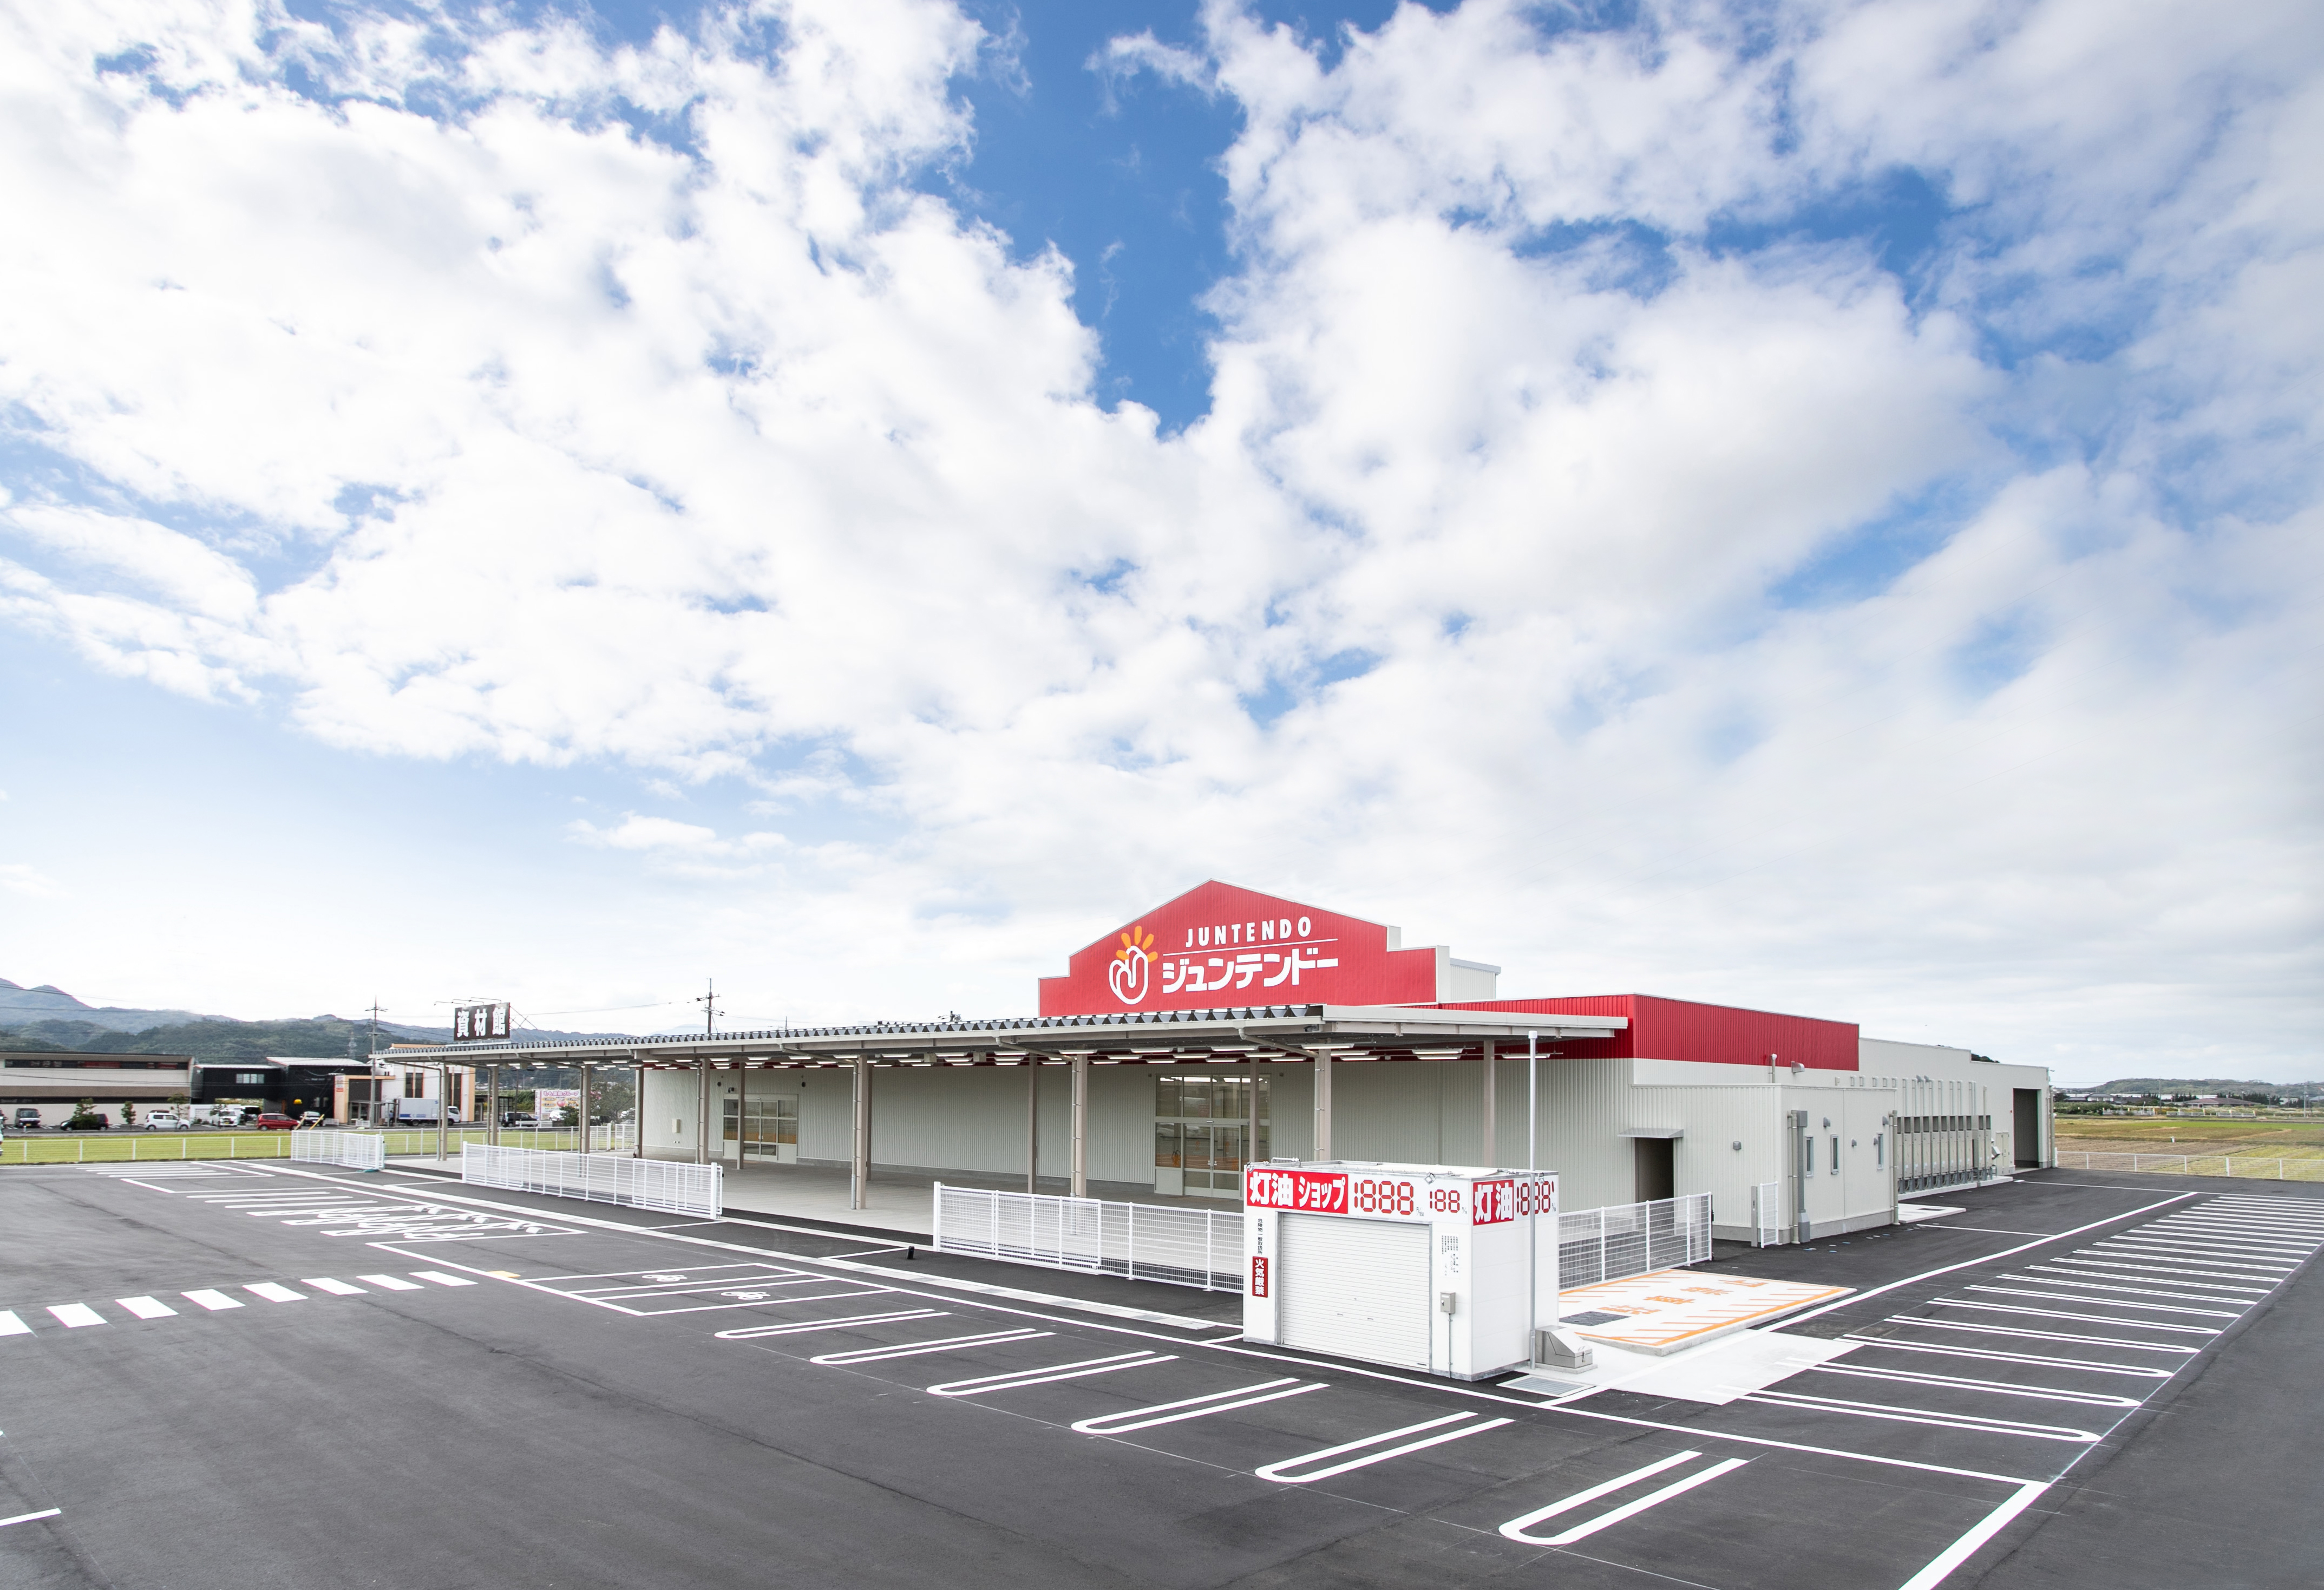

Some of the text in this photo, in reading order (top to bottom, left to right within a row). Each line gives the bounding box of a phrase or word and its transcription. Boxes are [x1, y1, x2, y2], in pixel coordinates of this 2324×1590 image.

[1186, 916, 1312, 947] JUNTENDO
[1162, 947, 1339, 994] ジュンテンドー
[456, 1007, 506, 1038] 資材館
[1249, 1172, 1346, 1212] 灯油 ショップ
[1474, 1182, 1513, 1223] 灯油
[1254, 1258, 1265, 1296] 火気厳禁
